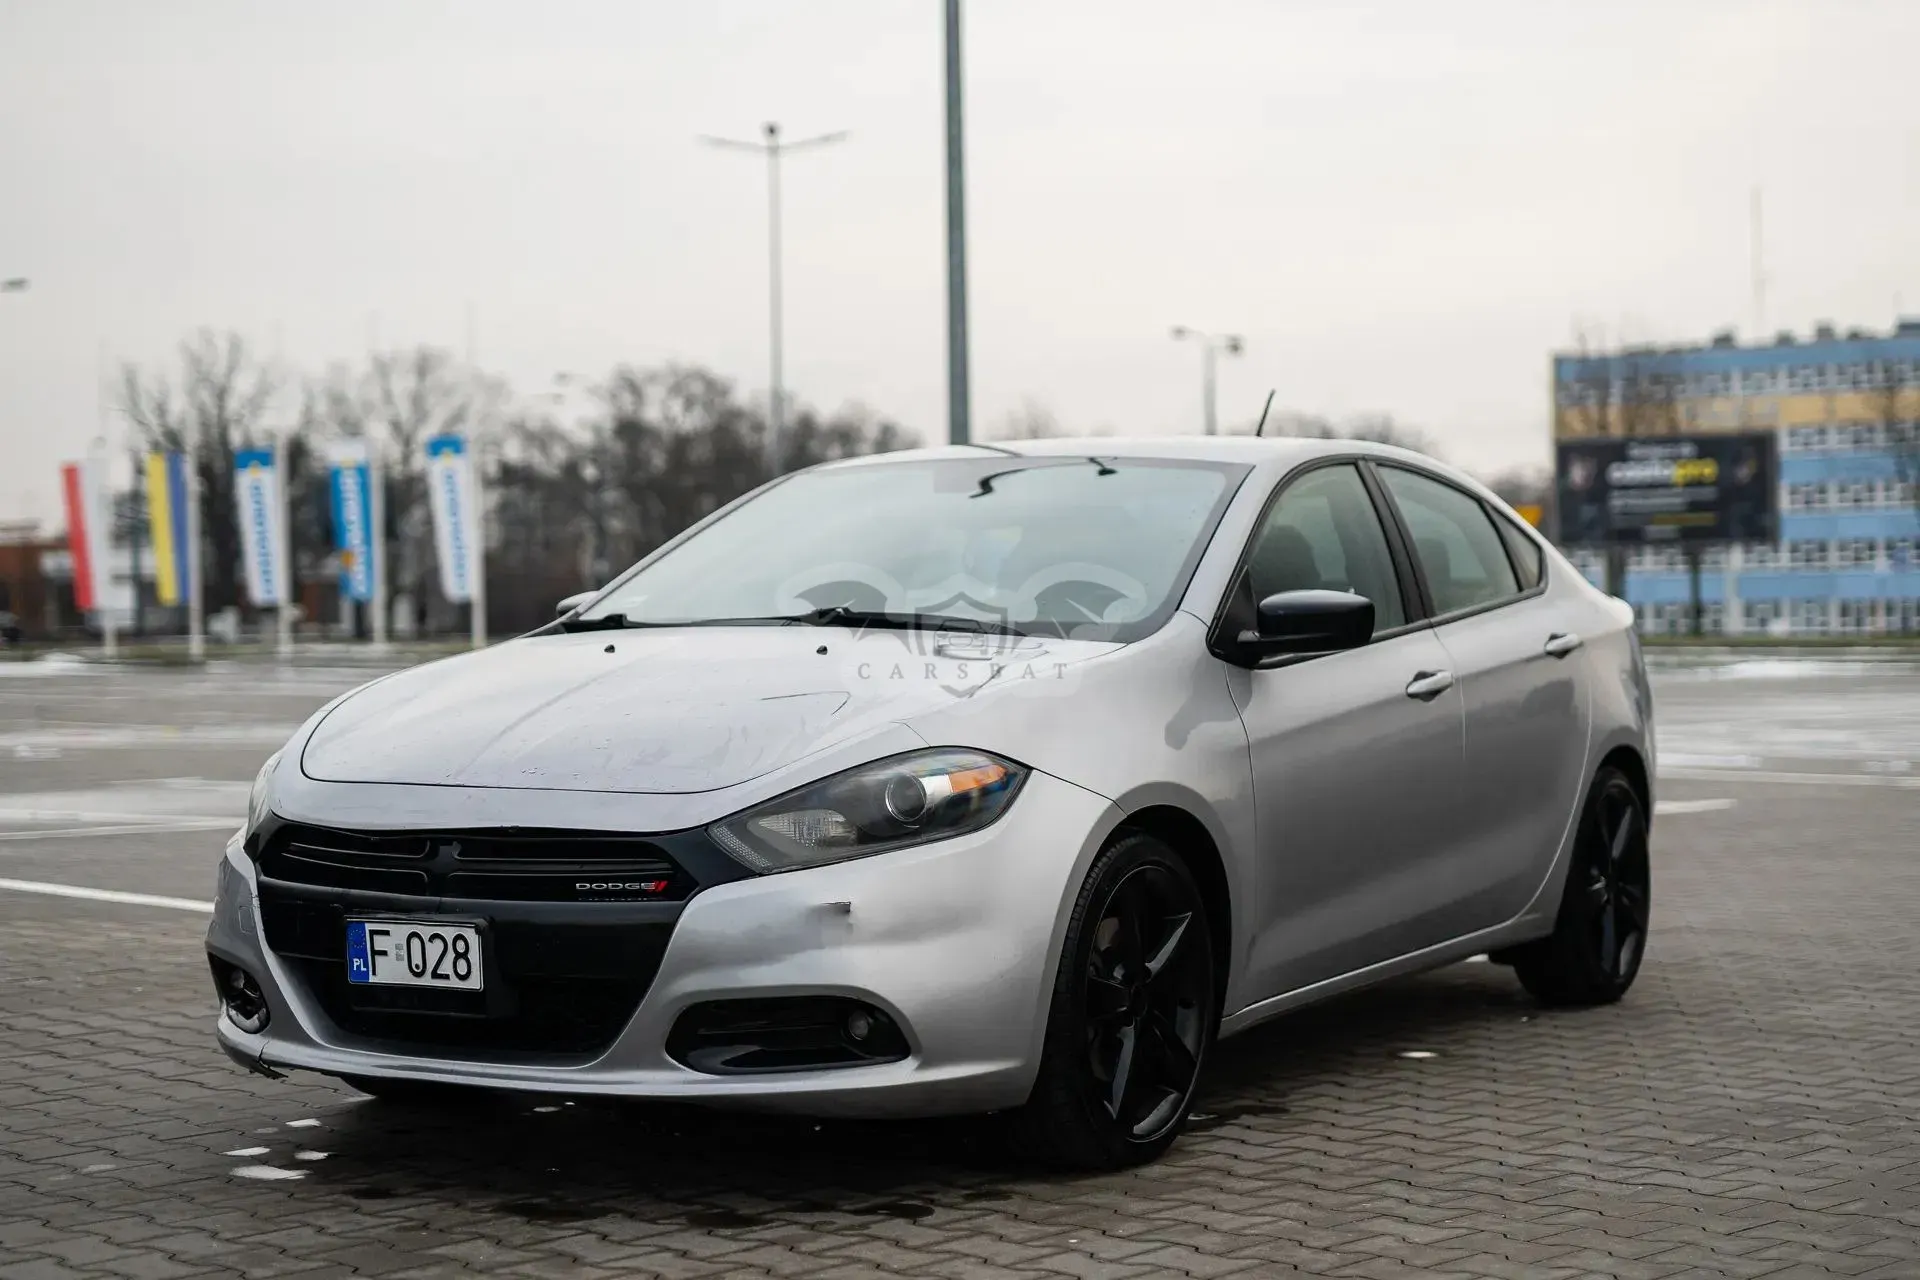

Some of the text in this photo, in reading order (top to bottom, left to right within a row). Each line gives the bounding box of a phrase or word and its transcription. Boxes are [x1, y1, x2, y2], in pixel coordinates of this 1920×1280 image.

[575, 882, 656, 890] DODGE
[367, 928, 472, 981] F 028
[352, 958, 367, 972] PL
